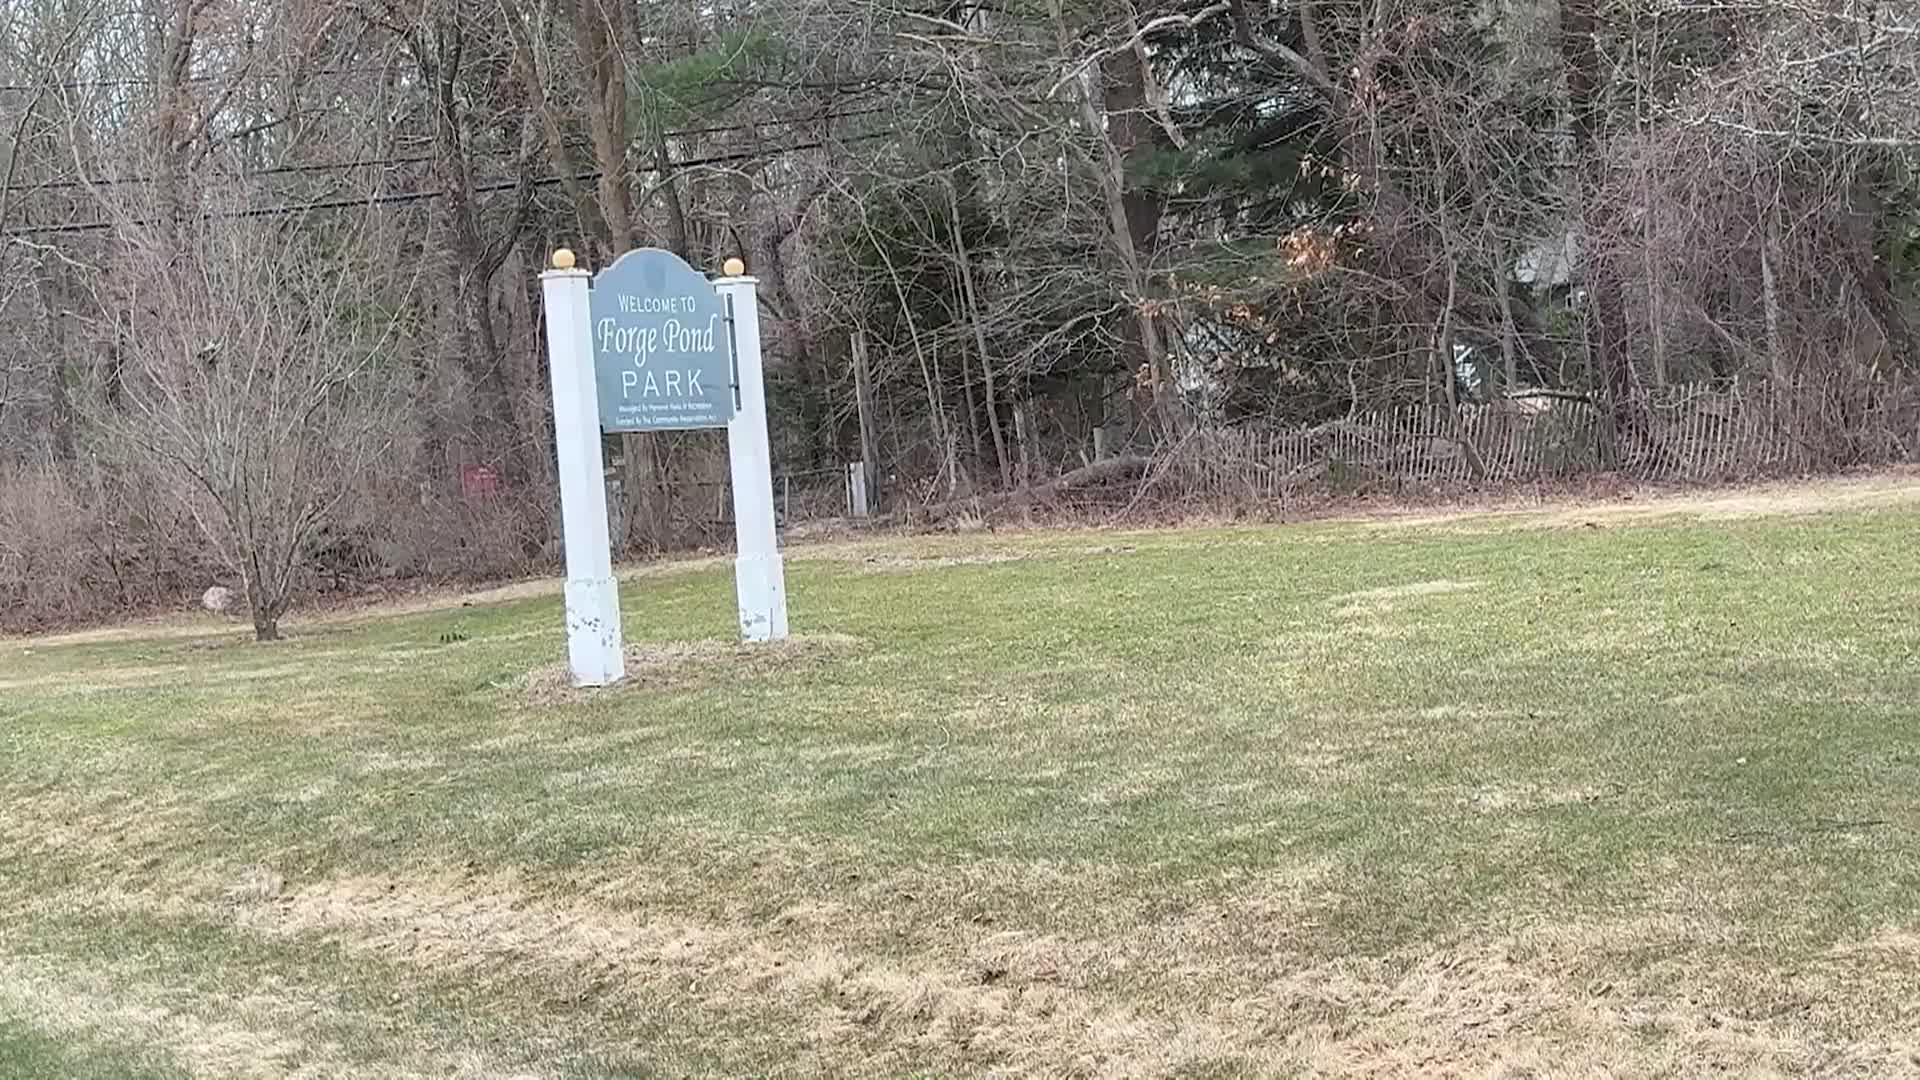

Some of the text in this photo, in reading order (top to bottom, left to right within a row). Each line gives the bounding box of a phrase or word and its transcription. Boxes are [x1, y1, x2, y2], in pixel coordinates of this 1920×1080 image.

[618, 294, 696, 313] WELCOME TO
[598, 313, 718, 368] Forge Pond
[622, 369, 704, 398] PARK
